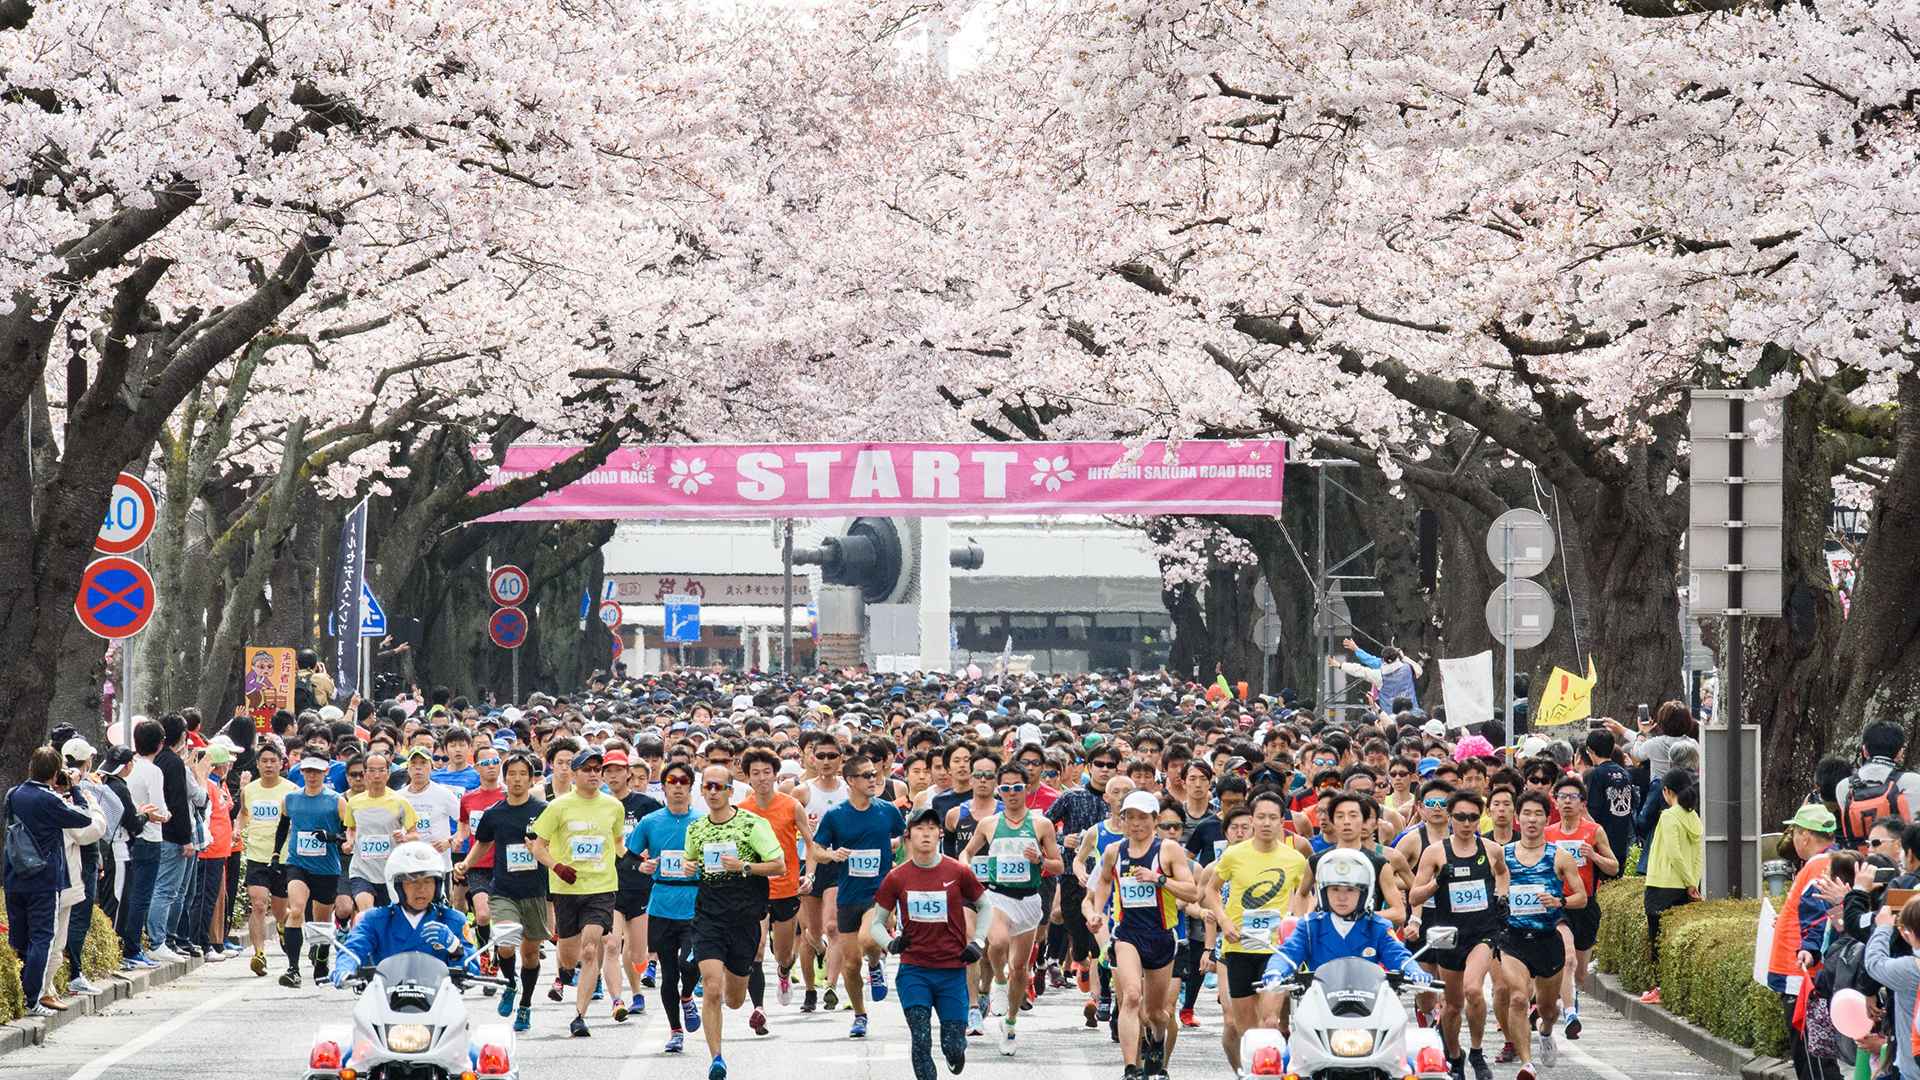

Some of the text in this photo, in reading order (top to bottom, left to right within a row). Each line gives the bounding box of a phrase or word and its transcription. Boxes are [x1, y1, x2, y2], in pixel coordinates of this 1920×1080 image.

[582, 471, 617, 484] ROAD
[621, 471, 655, 484] RACE
[736, 450, 1018, 500] START
[1088, 465, 1272, 480] HITCHI SAKURA ROAD RACE
[498, 578, 520, 595] 40
[602, 609, 616, 622] 40
[279, 652, 291, 693] 歩行者に
[253, 807, 278, 816] 2010
[362, 842, 389, 852] 3709
[577, 844, 599, 854] 621
[850, 858, 879, 868] 1192
[1001, 863, 1025, 874] 328
[1122, 886, 1154, 898] 1509
[1455, 889, 1481, 904] 394
[1515, 893, 1540, 905] 622
[914, 901, 940, 913] 145
[1252, 918, 1270, 929] 85
[387, 984, 435, 995] POLICE
[1327, 989, 1375, 1000] POLICE
